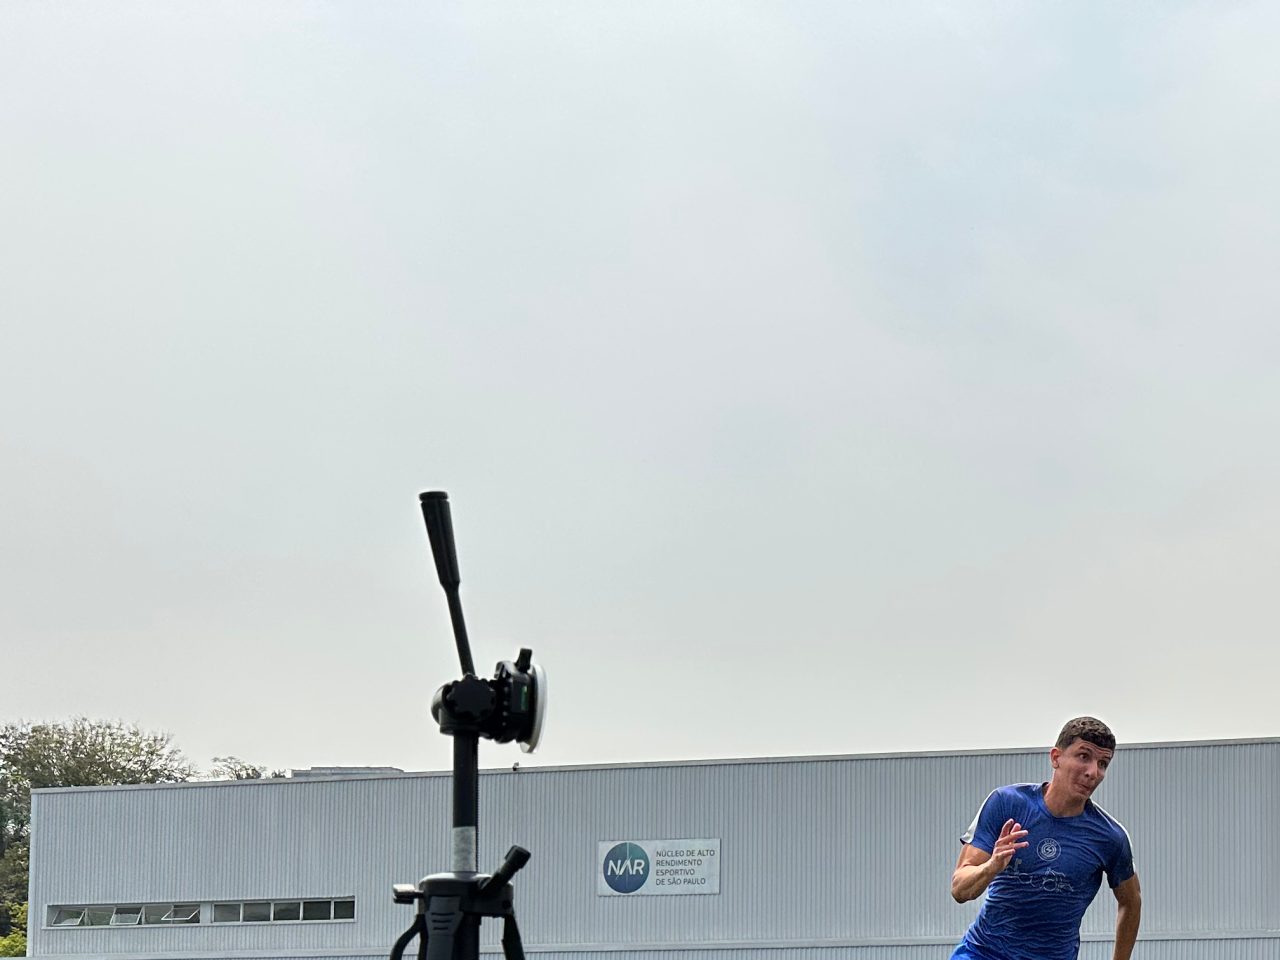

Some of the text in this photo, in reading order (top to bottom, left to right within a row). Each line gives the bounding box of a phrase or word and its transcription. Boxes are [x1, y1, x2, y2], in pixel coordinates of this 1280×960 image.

[656, 849, 684, 857] NÚCLEO
[698, 849, 716, 857] ALTO
[607, 858, 645, 876] NAR
[656, 868, 695, 876] ESPORTIVO
[667, 877, 682, 886] SÃO
[683, 877, 706, 885] PAULO
